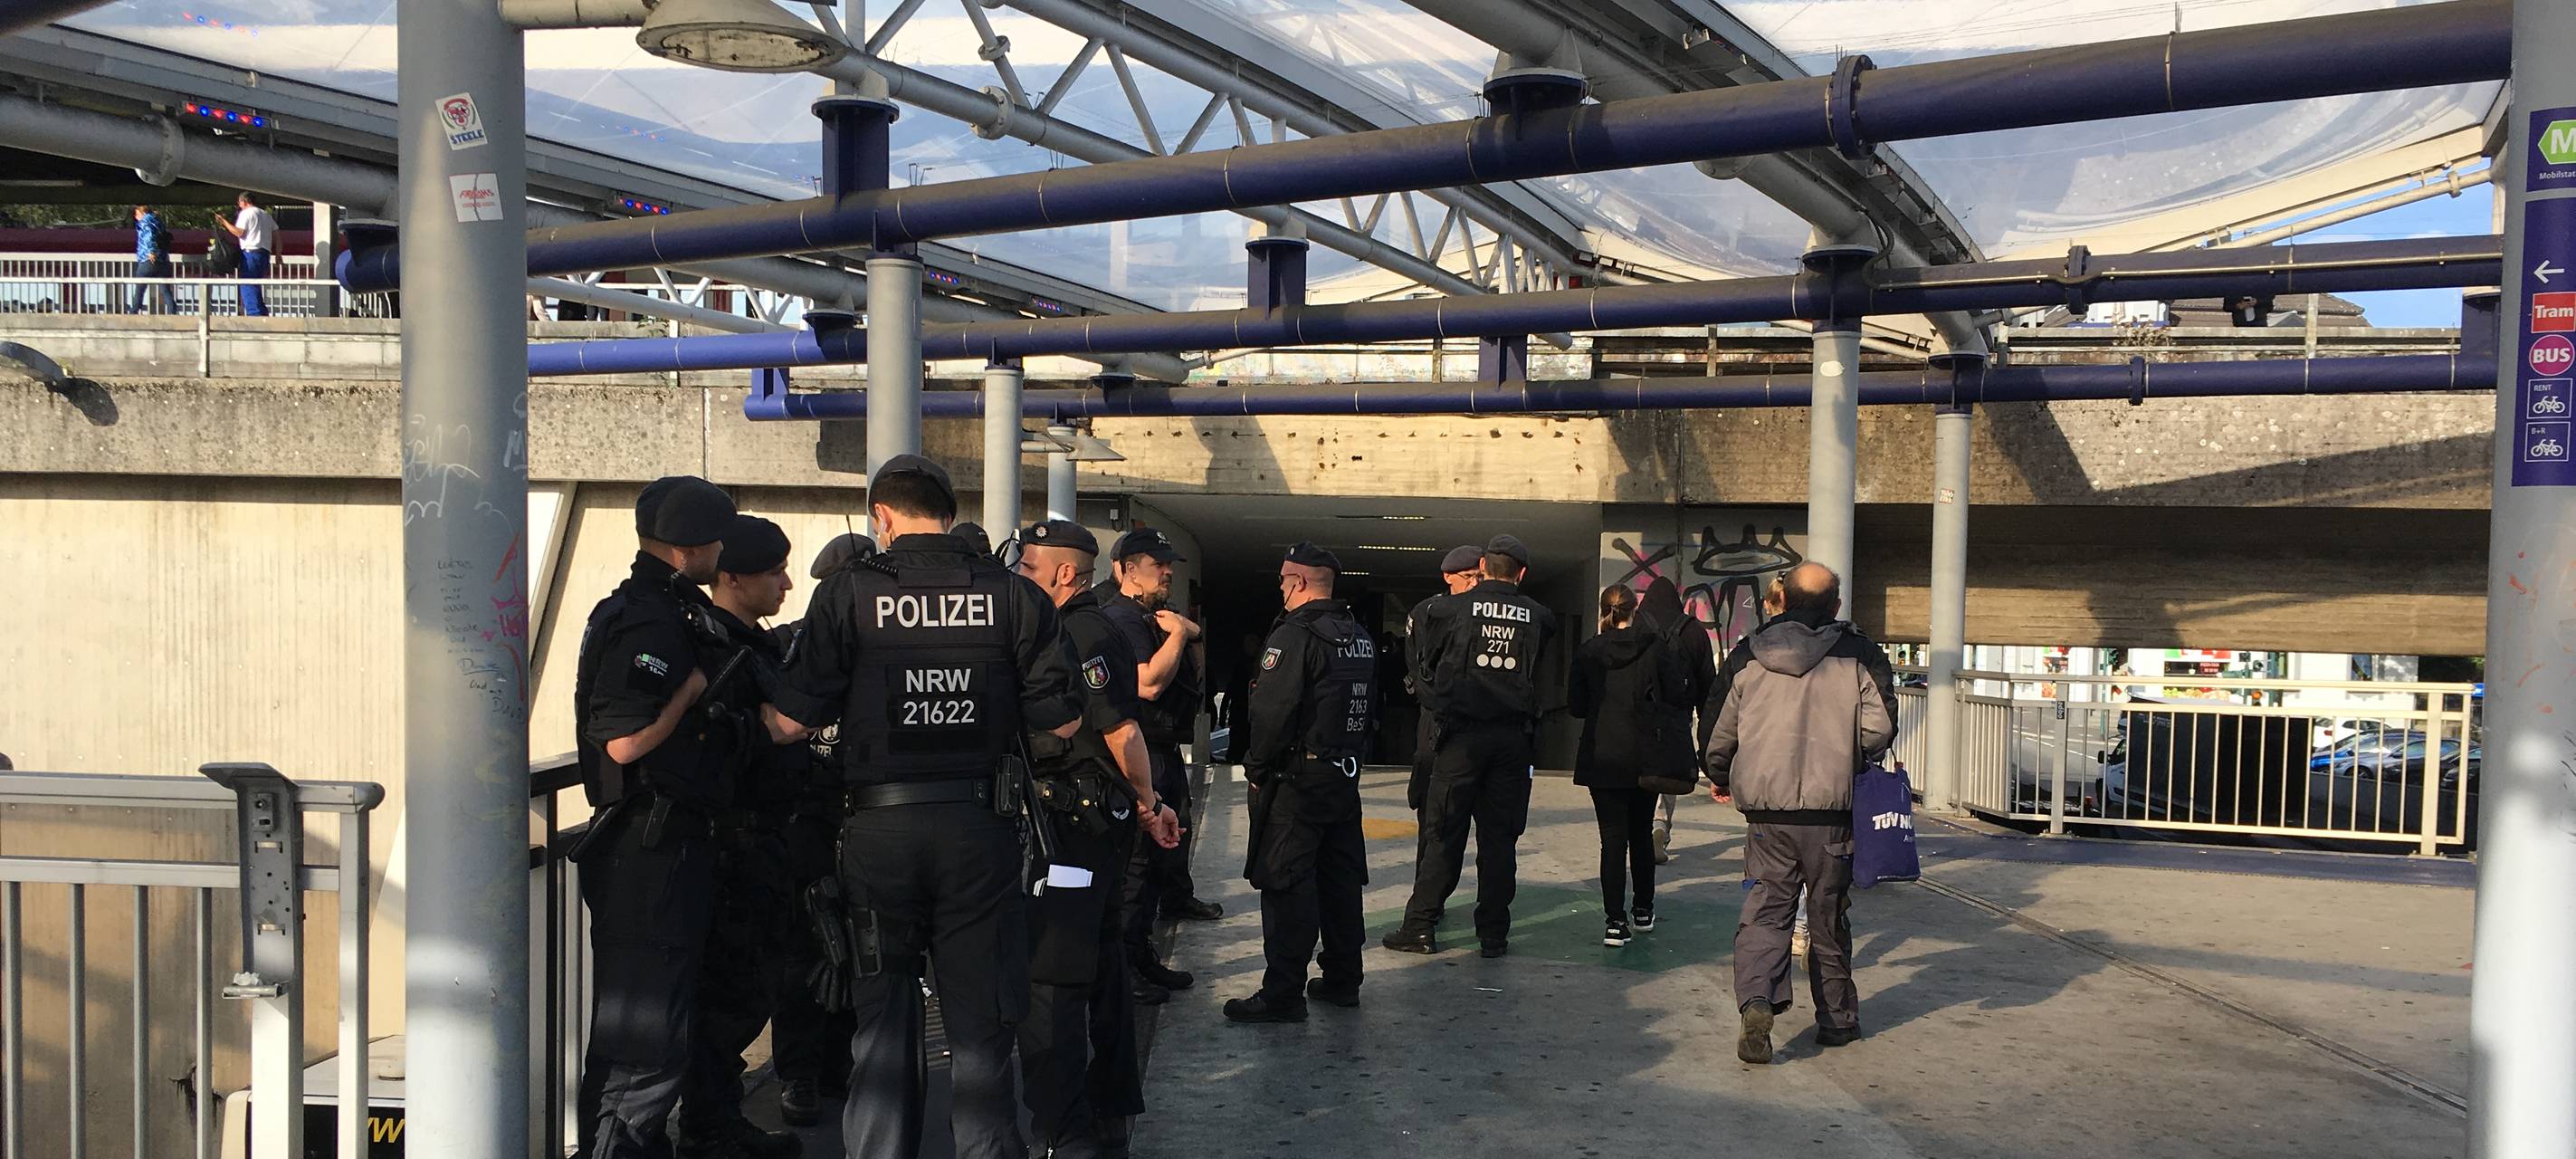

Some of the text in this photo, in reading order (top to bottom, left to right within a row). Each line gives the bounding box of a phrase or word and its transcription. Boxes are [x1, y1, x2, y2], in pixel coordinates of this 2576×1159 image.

[450, 129, 485, 145] STEELE
[2551, 128, 2576, 154] M
[2534, 305, 2574, 319] Tram
[2533, 347, 2571, 364] BUS
[2533, 384, 2552, 392] RENT
[875, 594, 995, 628] POLIZEI
[1472, 601, 1531, 623] POLIZEI
[1481, 624, 1515, 640] NRW
[1486, 639, 1510, 655] 271
[905, 668, 971, 693] NRW
[1351, 682, 1368, 696] NRW
[903, 699, 975, 725] 21622
